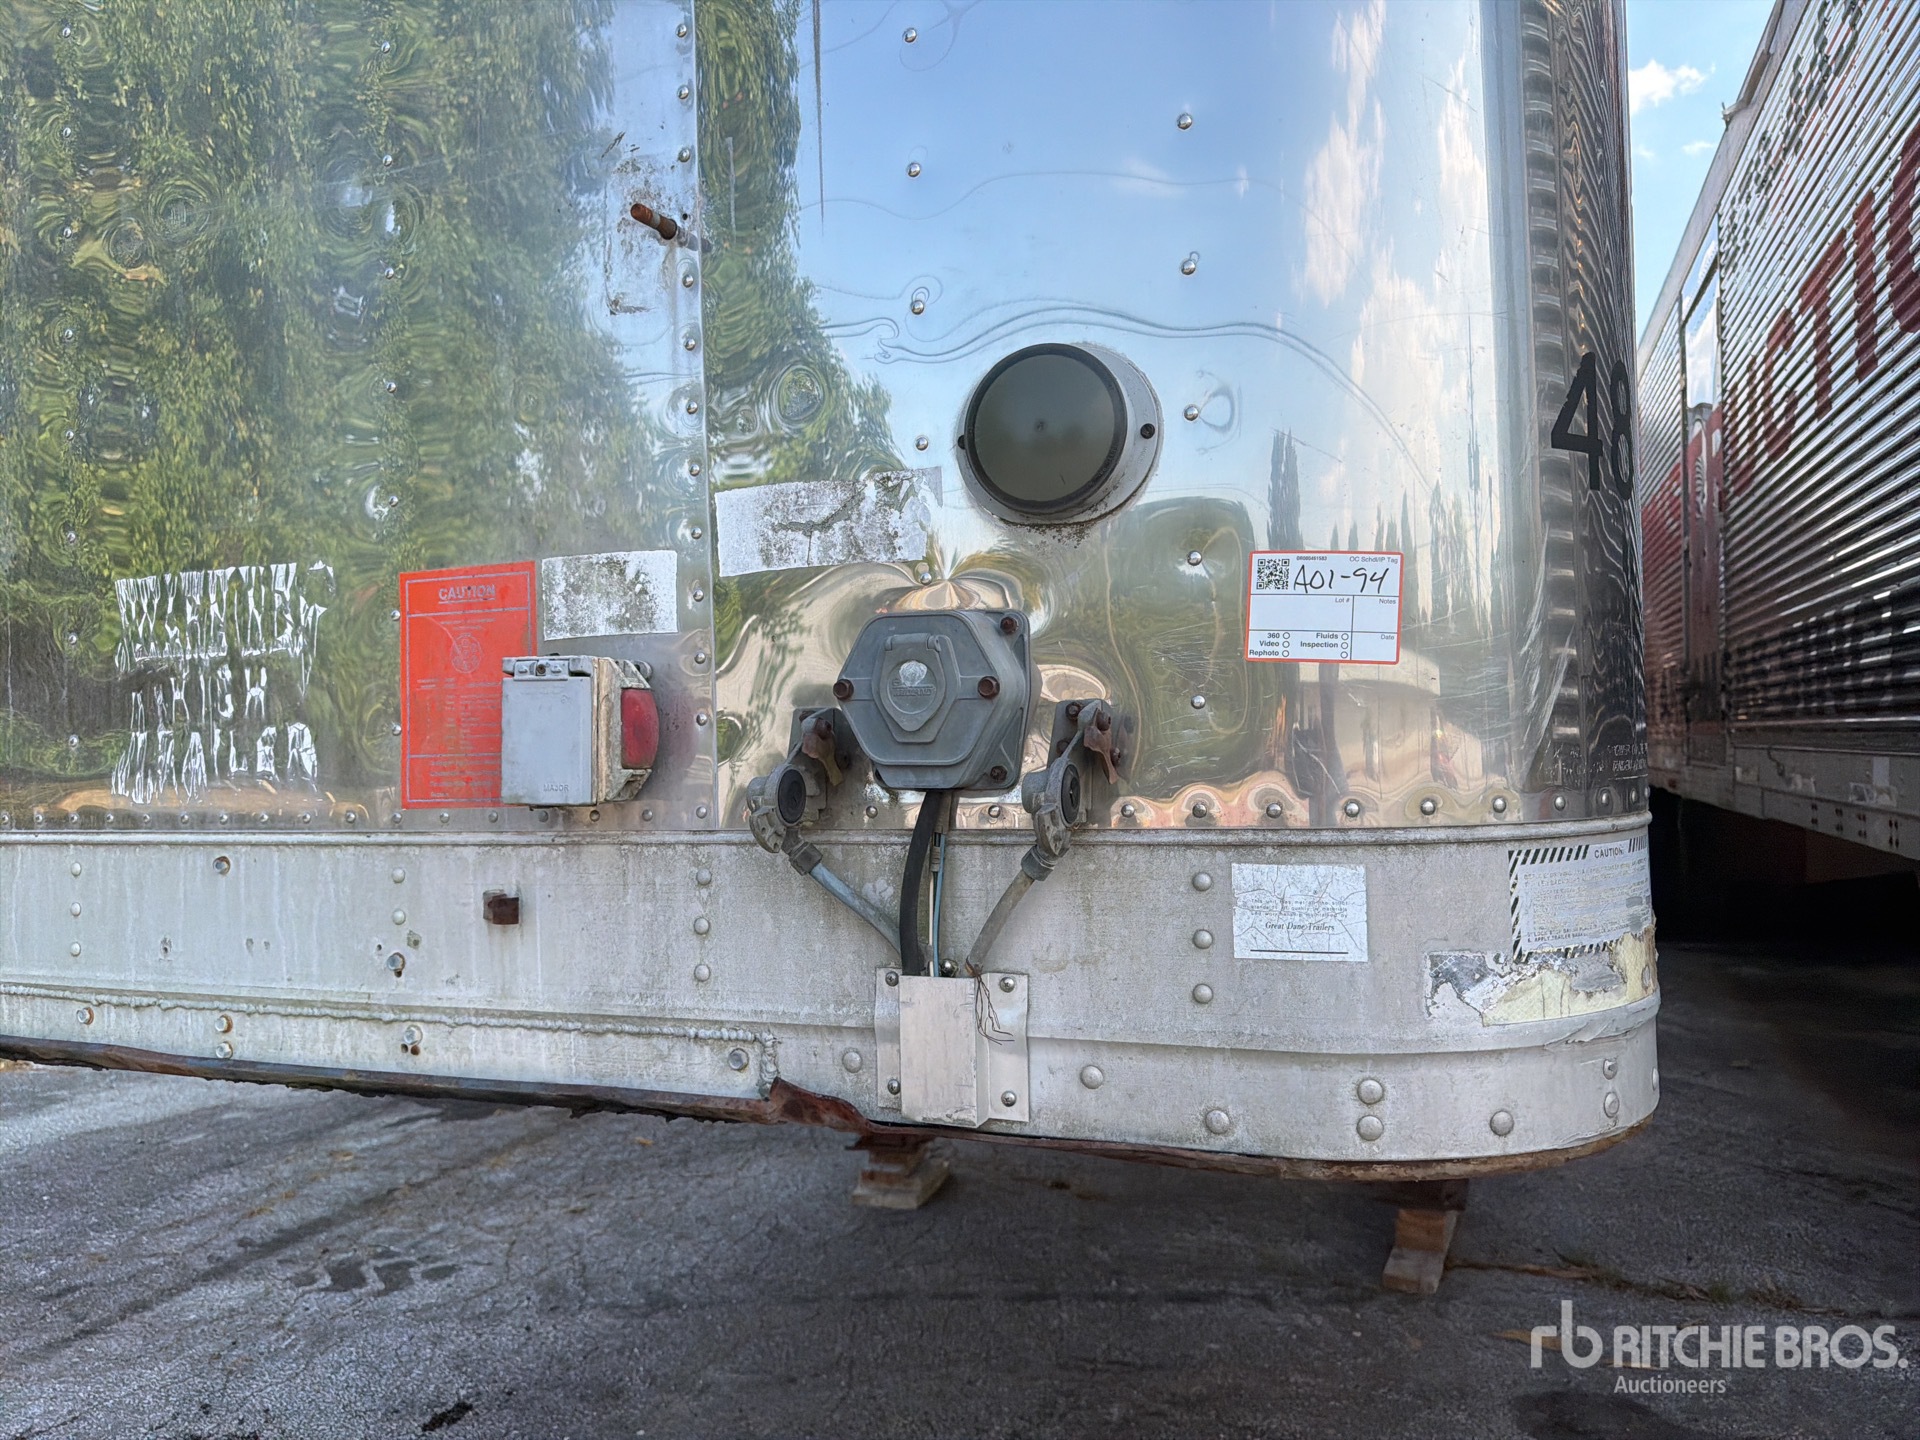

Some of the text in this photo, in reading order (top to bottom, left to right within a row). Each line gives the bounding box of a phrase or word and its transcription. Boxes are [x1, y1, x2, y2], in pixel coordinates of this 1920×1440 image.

[1551, 351, 1634, 500] 48
[1387, 556, 1399, 565] Tag
[438, 584, 496, 600] CAUTION
[1300, 641, 1339, 649] Inspection
[1265, 921, 1335, 931] Great Dane Trailers
